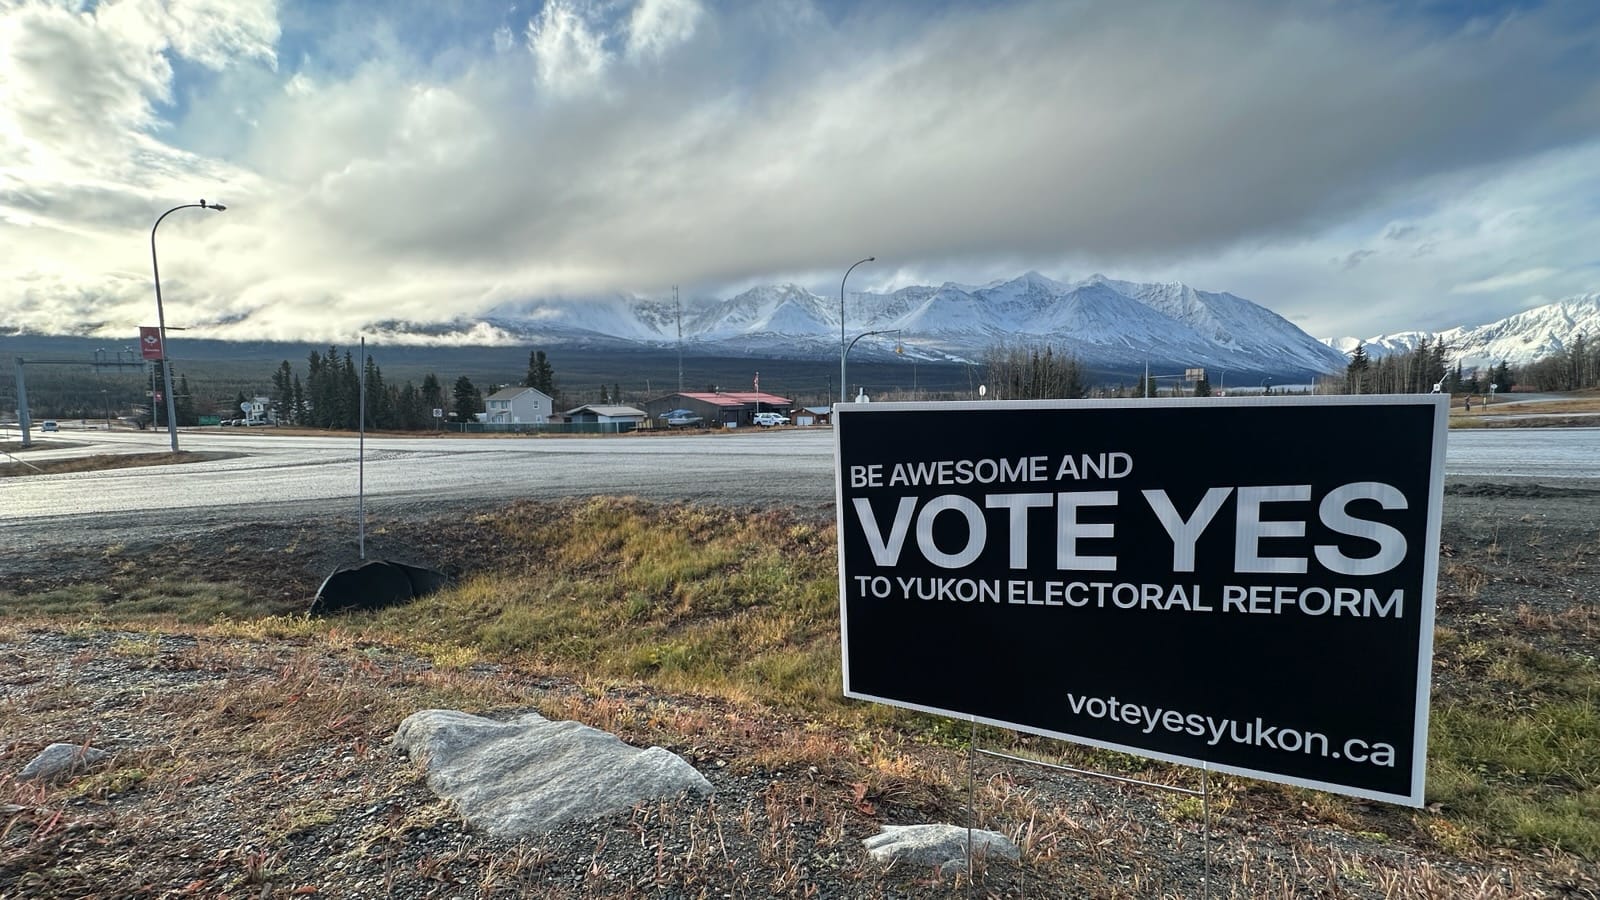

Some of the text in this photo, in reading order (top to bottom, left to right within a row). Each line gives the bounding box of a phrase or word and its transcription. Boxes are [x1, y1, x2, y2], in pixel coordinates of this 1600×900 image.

[850, 452, 1133, 488] BE AWESOME AND
[852, 481, 1409, 576] VOTE YES
[854, 575, 1404, 619] TO YUKON ELECTORAL REFORM
[1066, 693, 1396, 768] voteyesyukon.ca
